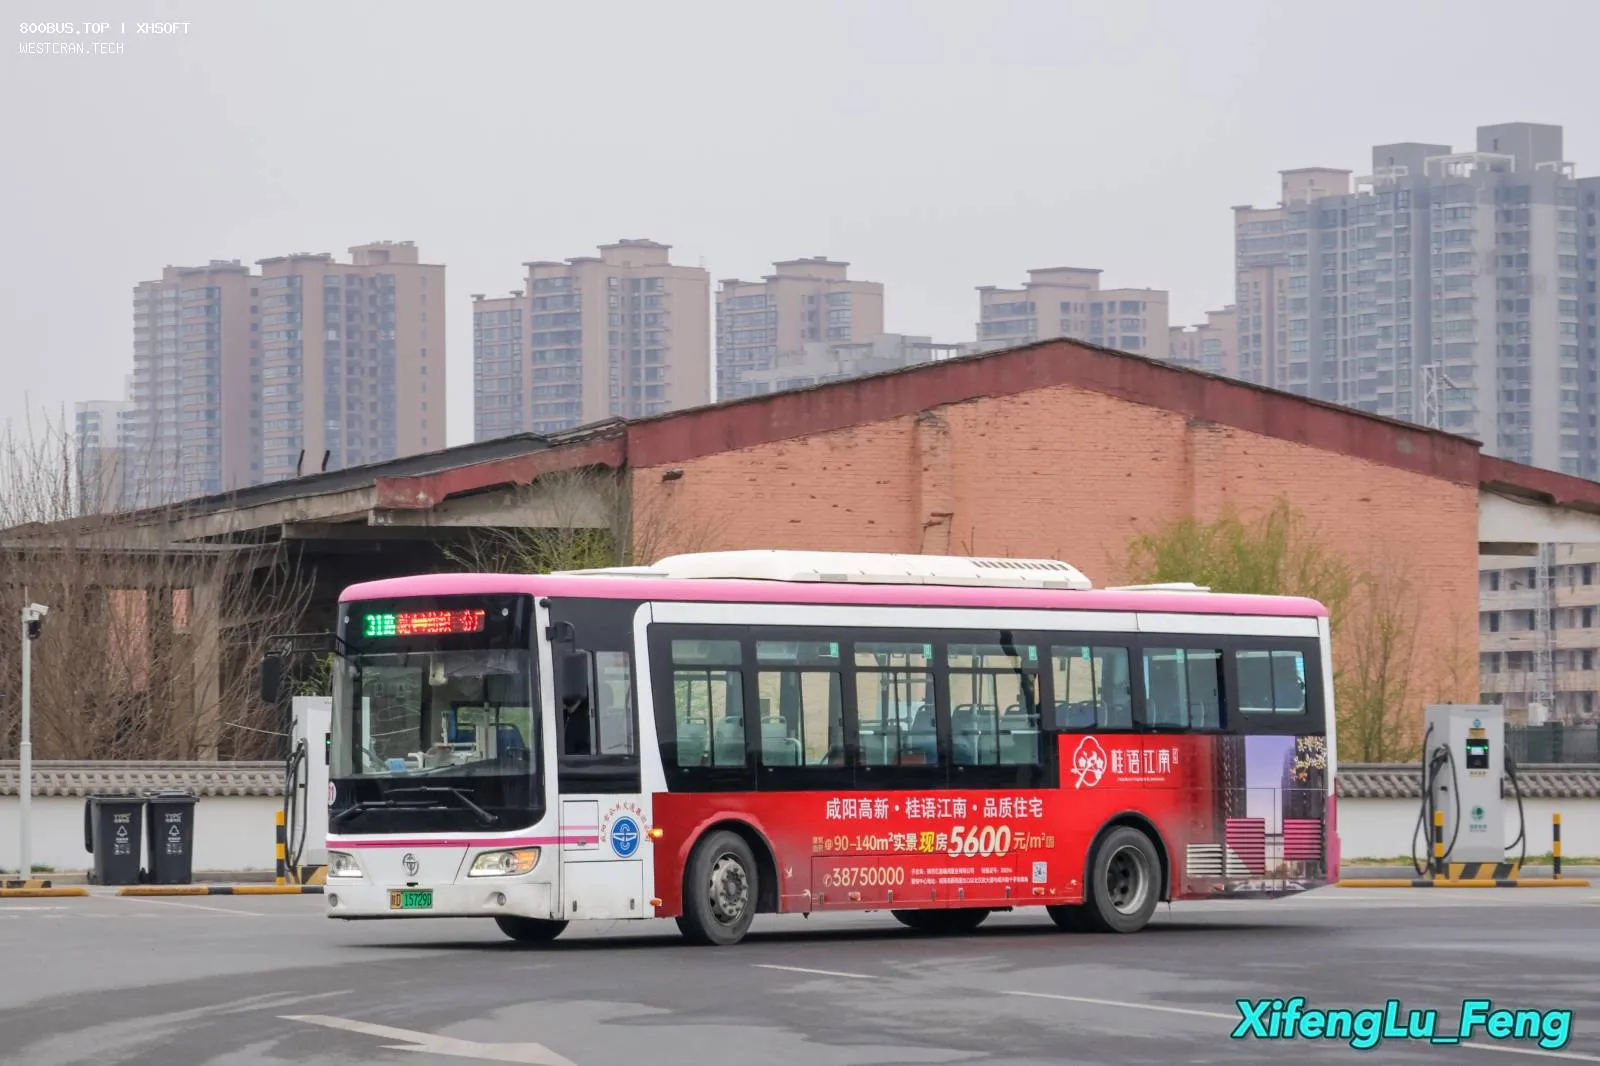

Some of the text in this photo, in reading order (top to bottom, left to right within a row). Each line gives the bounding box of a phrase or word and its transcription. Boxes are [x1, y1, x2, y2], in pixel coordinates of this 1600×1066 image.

[1111, 749, 1171, 774] 桂语江南
[832, 866, 905, 887] 38750000
